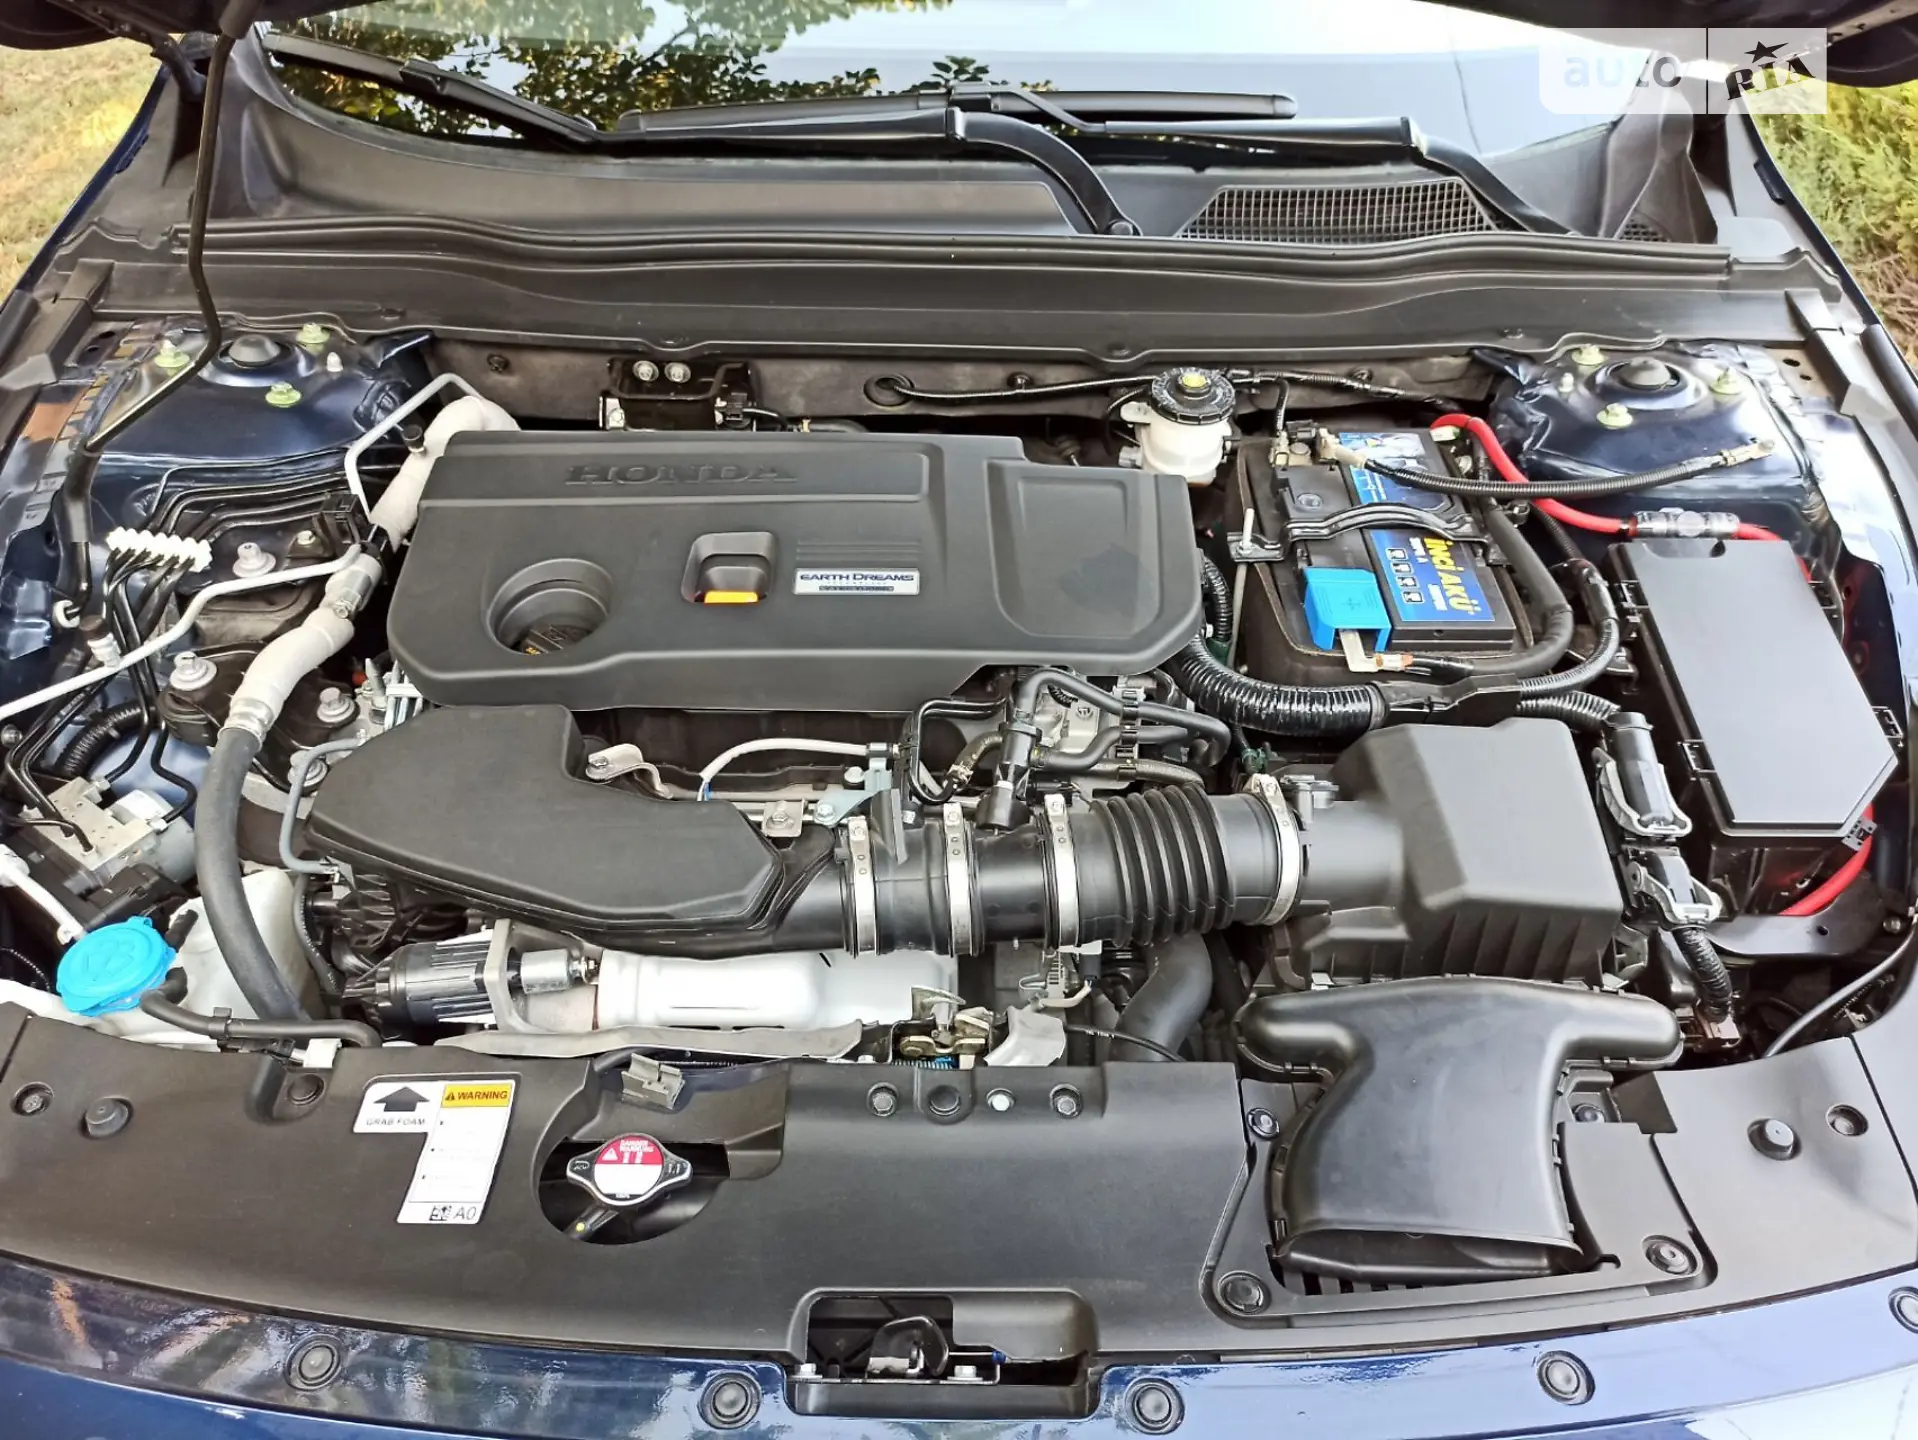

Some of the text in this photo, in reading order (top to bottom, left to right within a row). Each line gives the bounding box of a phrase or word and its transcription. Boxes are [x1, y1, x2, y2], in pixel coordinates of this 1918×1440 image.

[564, 465, 798, 486] HONDA
[800, 572, 914, 581] EARTH DREAMS
[458, 1091, 508, 1101] WARNING
